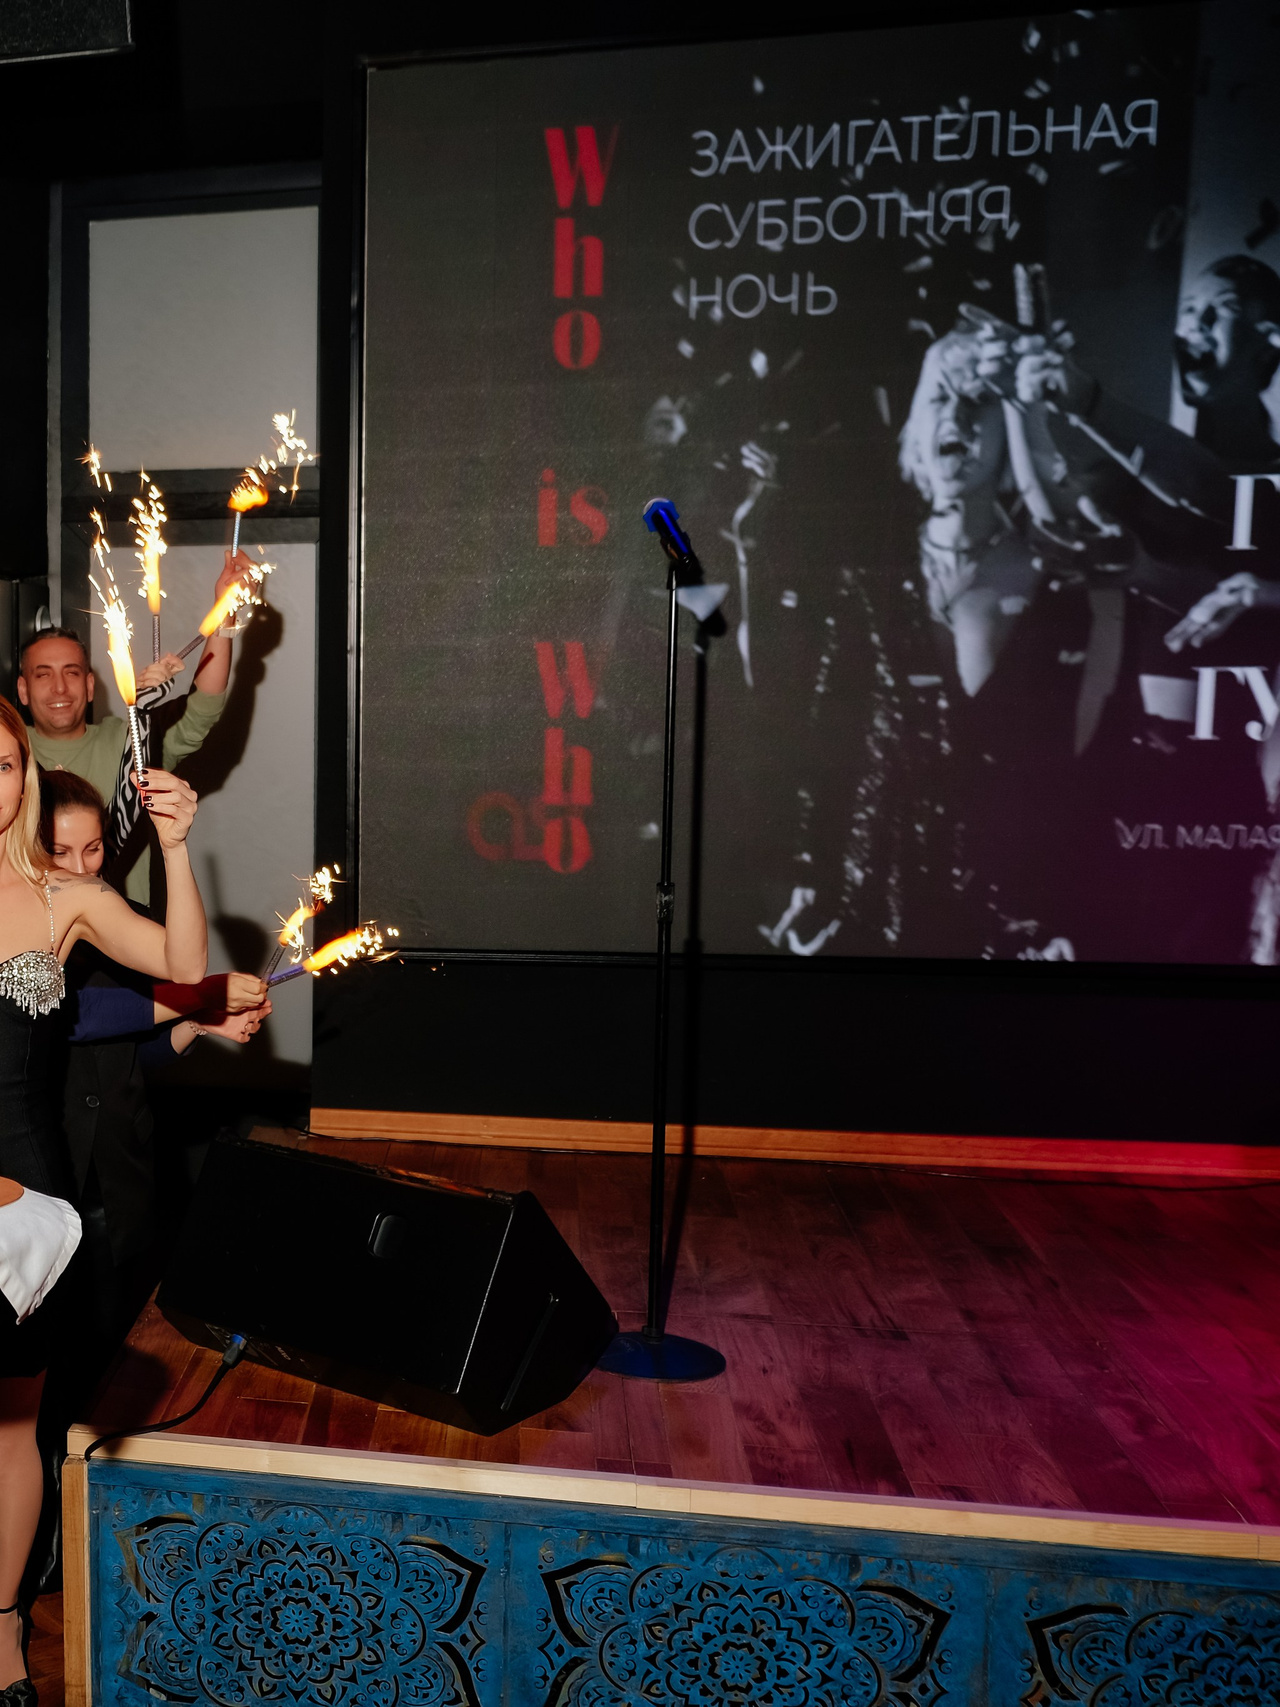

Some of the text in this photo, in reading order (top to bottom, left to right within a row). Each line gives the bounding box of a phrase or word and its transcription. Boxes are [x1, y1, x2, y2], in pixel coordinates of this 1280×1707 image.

[688, 98, 1160, 178] ЗАЖИГАТЕЛЬНАЯ
[688, 184, 1013, 251] СУББОТНЯЯ
[688, 271, 839, 319] НОЧЬ
[534, 124, 618, 874] Who is Who
